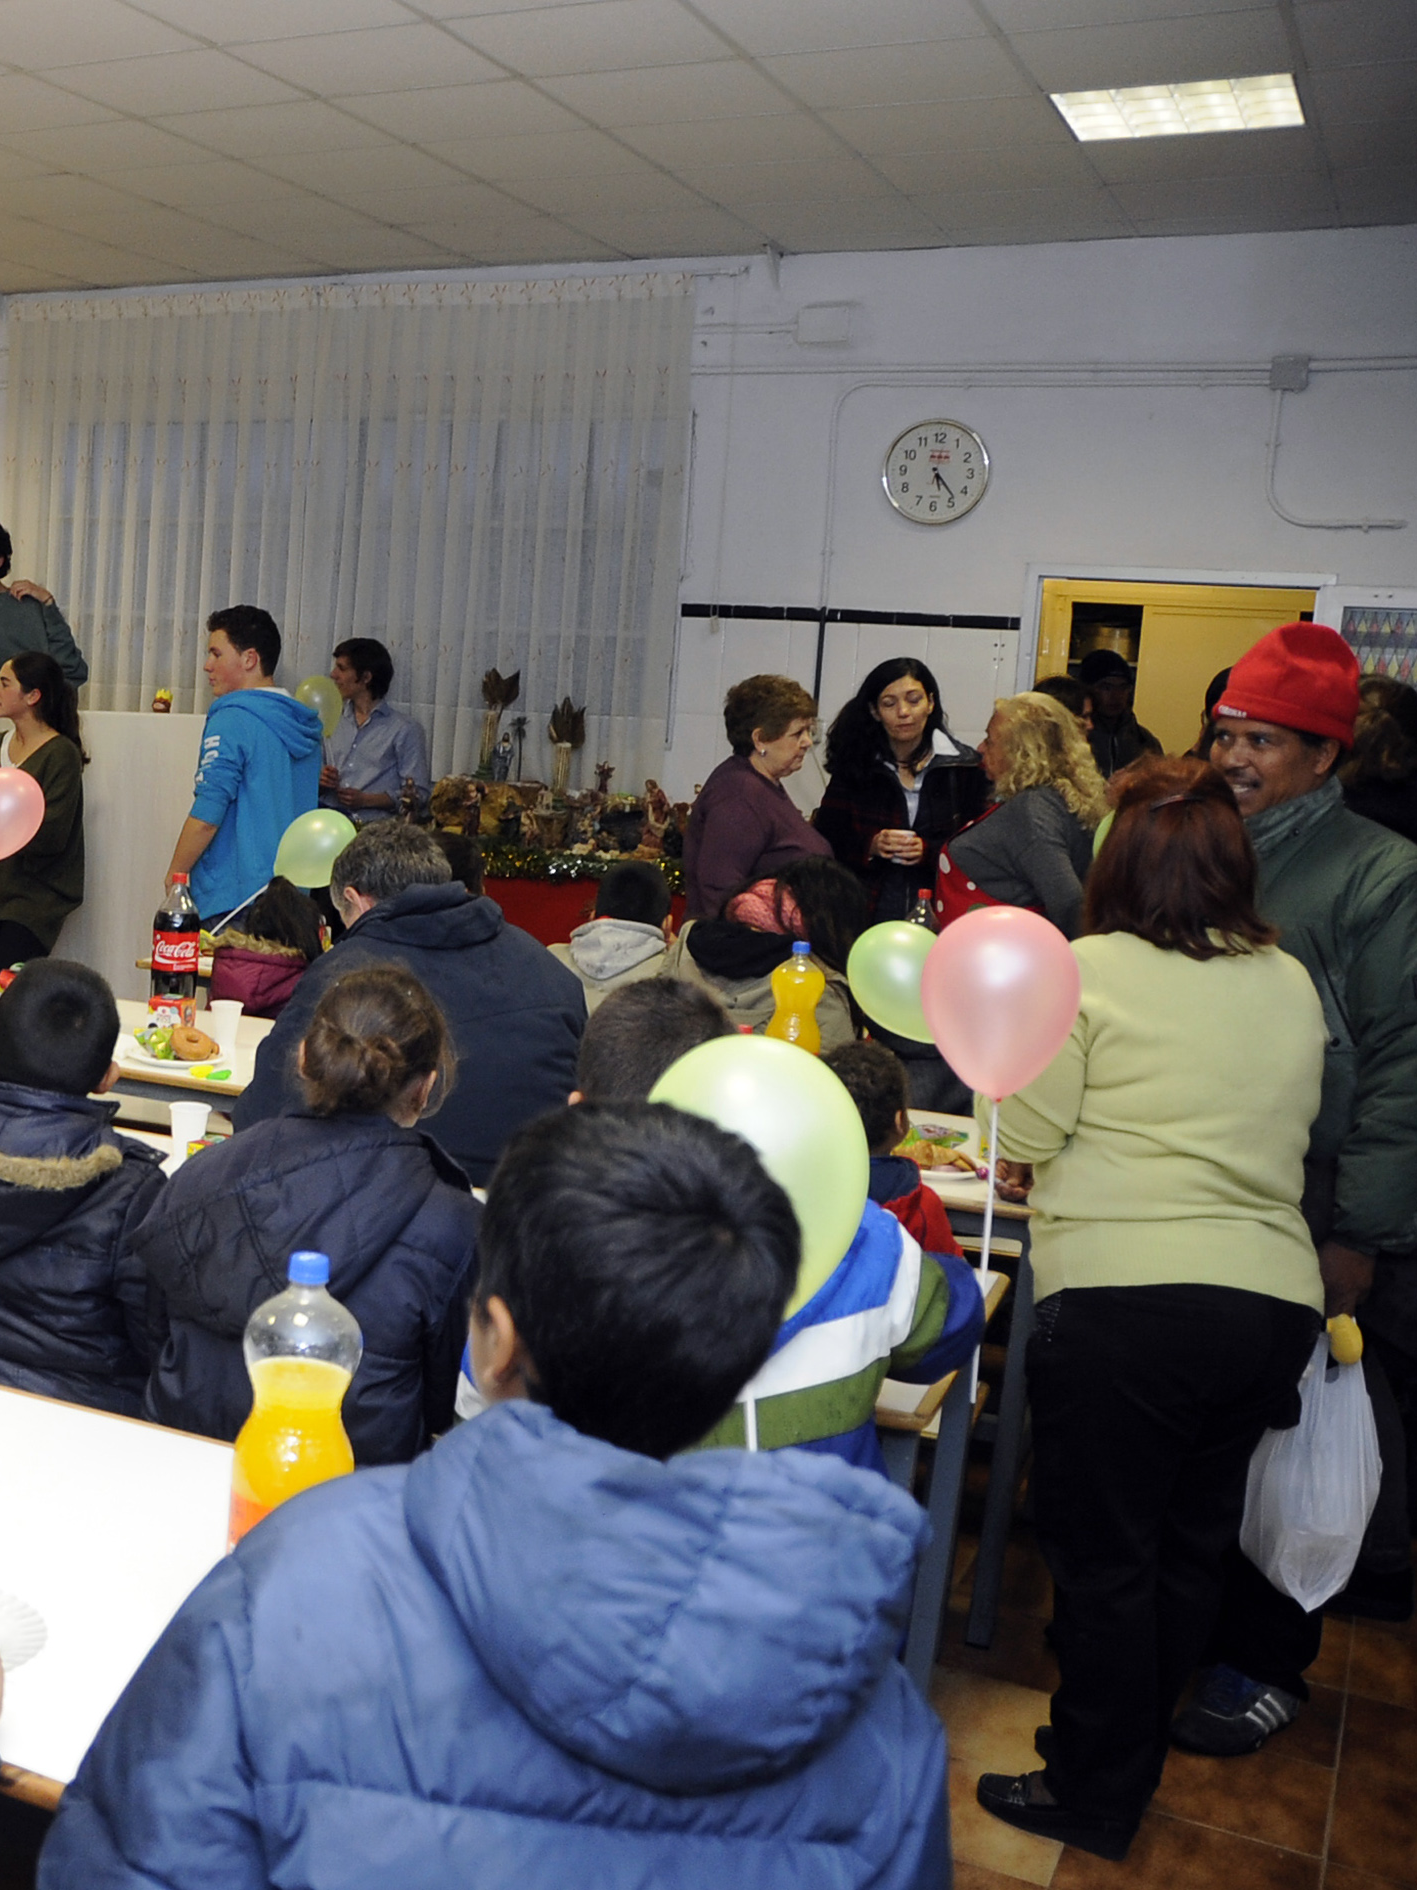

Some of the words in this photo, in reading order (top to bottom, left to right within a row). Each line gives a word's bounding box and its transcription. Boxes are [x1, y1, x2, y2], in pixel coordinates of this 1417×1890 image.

[918, 436, 928, 447] 11
[934, 432, 947, 444] 12
[955, 438, 960, 449] 1
[904, 449, 917, 461] 10
[963, 452, 972, 464] 2
[899, 464, 908, 476] 9
[966, 468, 975, 480] 3
[901, 482, 909, 493] 8
[960, 485, 968, 496] 4
[915, 495, 923, 506] 7
[946, 497, 955, 508] 5
[929, 501, 938, 512] 6
